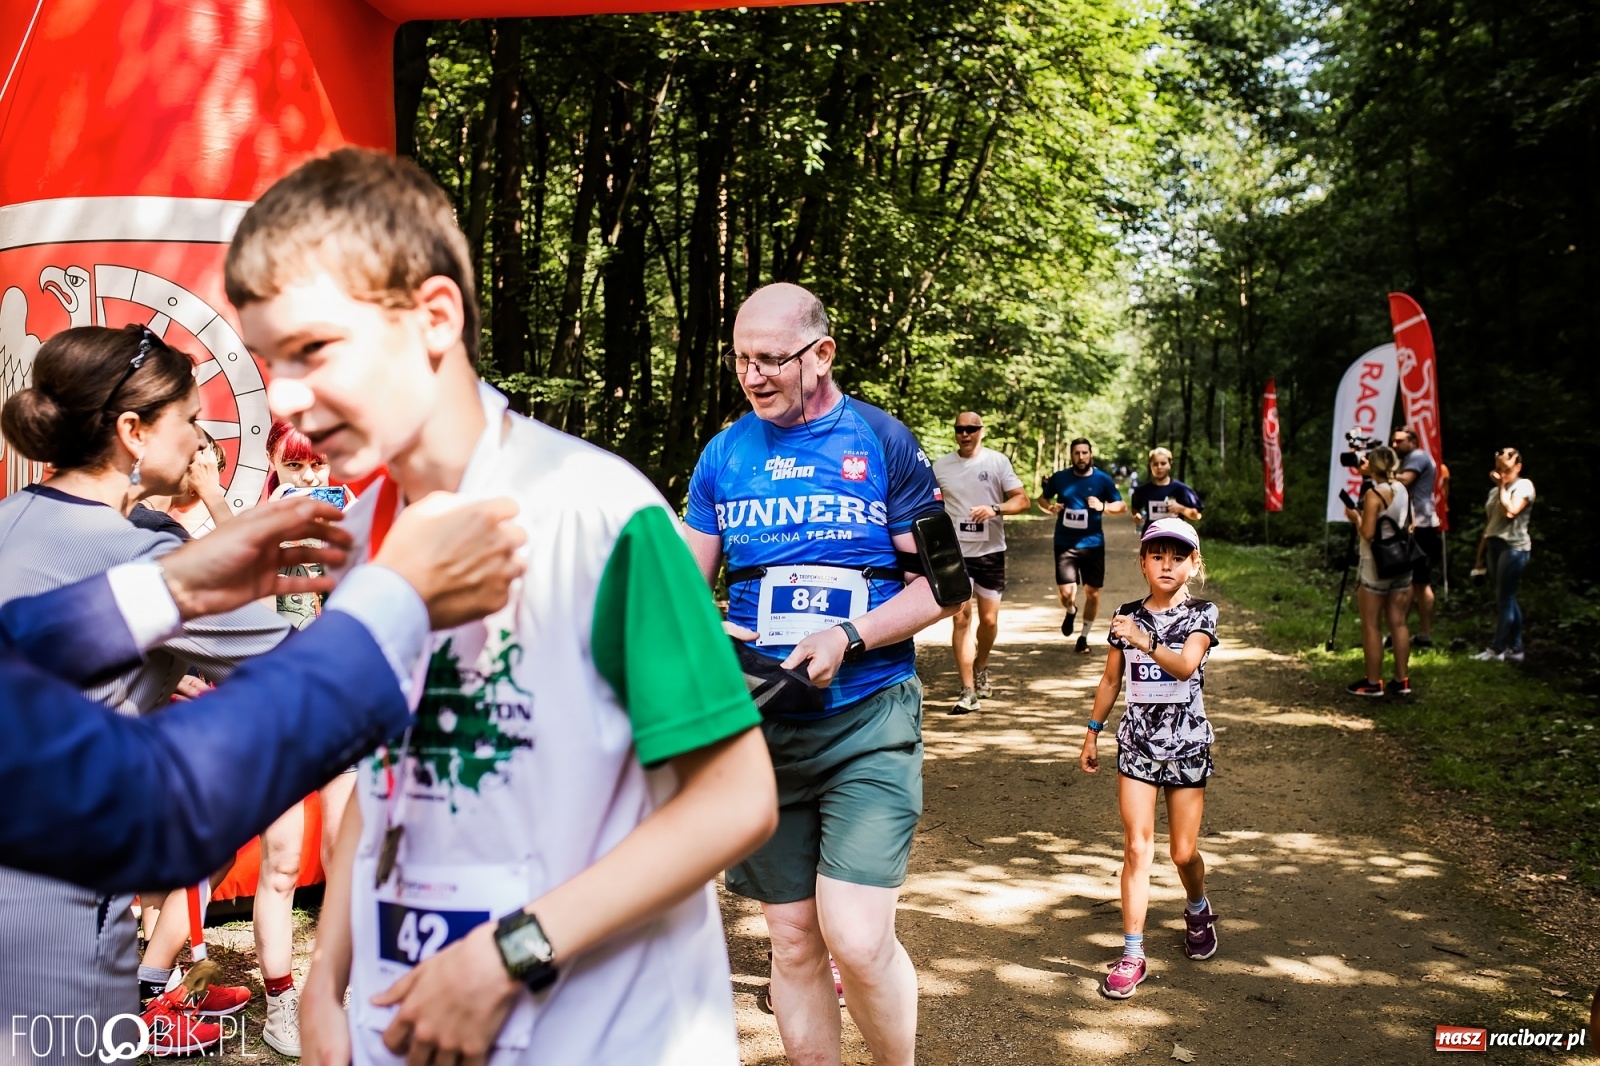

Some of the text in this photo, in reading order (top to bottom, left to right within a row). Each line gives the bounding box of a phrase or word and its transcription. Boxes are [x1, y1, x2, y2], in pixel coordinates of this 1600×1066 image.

[714, 494, 888, 531] RUNNERS
[805, 530, 853, 540] TEAM
[791, 588, 830, 612] 84
[1138, 664, 1162, 680] 96
[397, 910, 449, 963] 42
